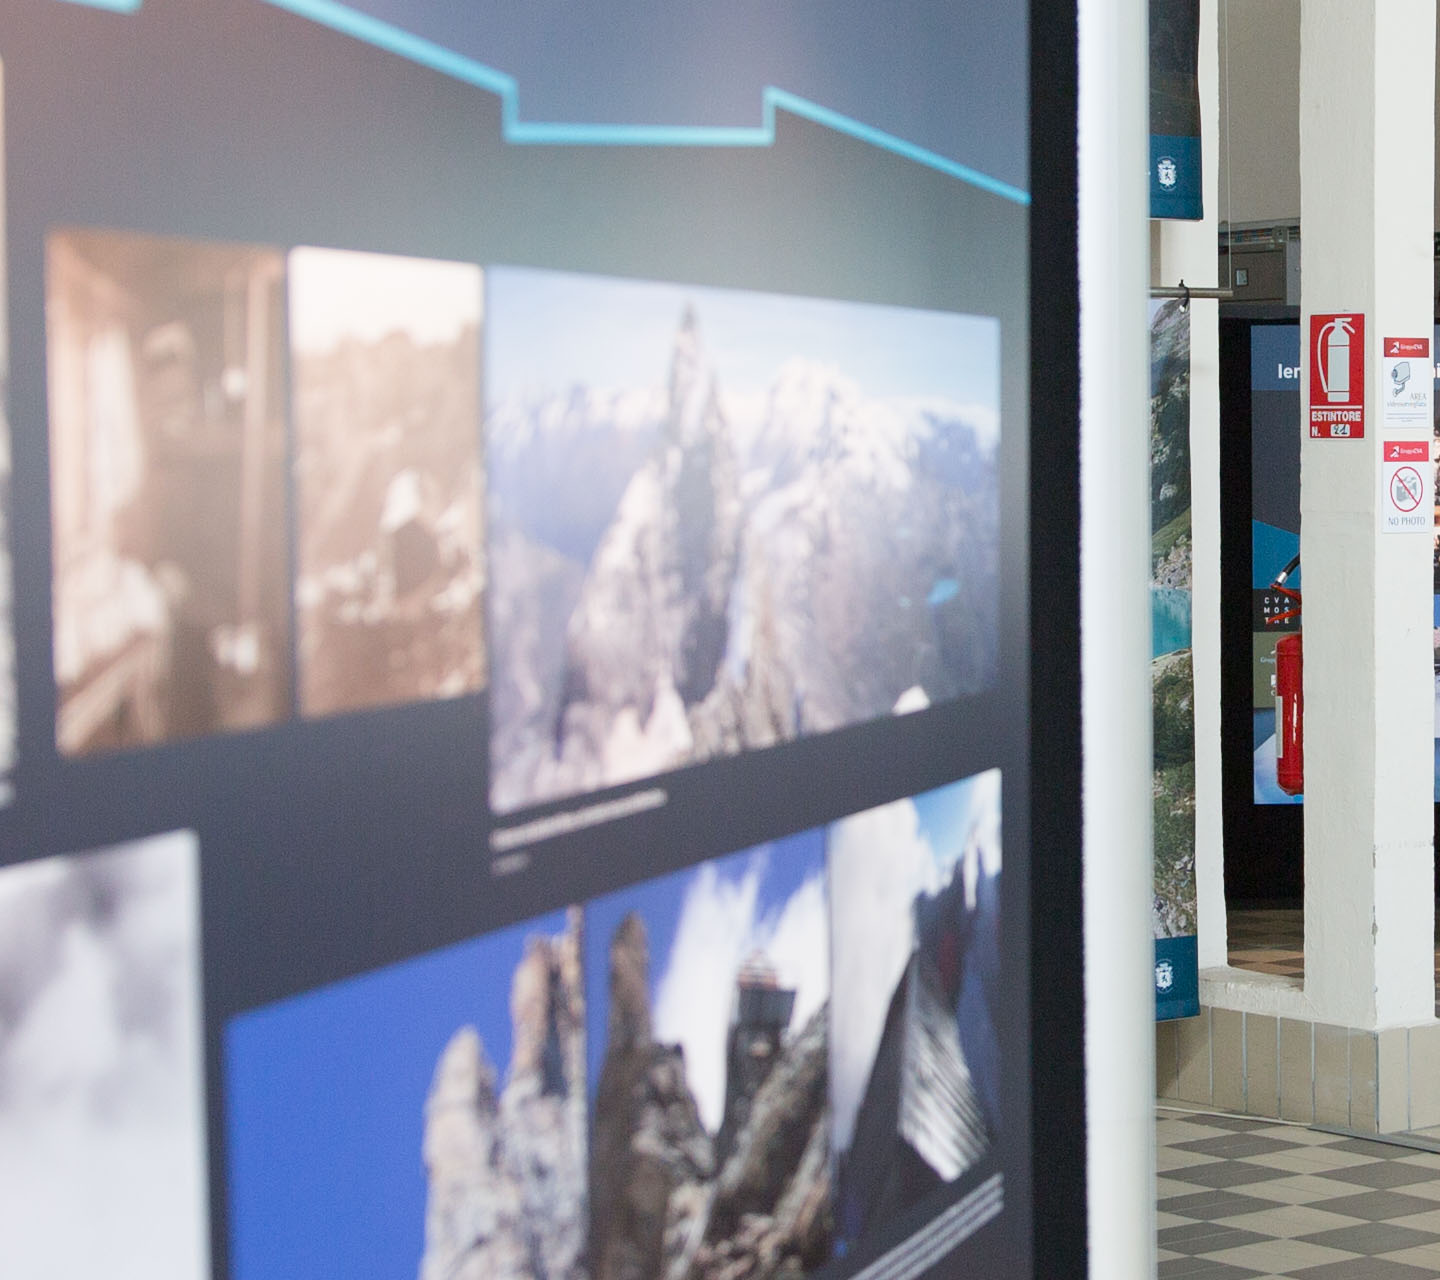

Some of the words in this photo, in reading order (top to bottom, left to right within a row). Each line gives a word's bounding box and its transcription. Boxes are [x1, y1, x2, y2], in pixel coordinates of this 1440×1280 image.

[1311, 410, 1362, 422] ESTINTORE
[1311, 426, 1321, 437] N.
[1388, 516, 1399, 526] NO
[1401, 516, 1426, 526] PHOTO
